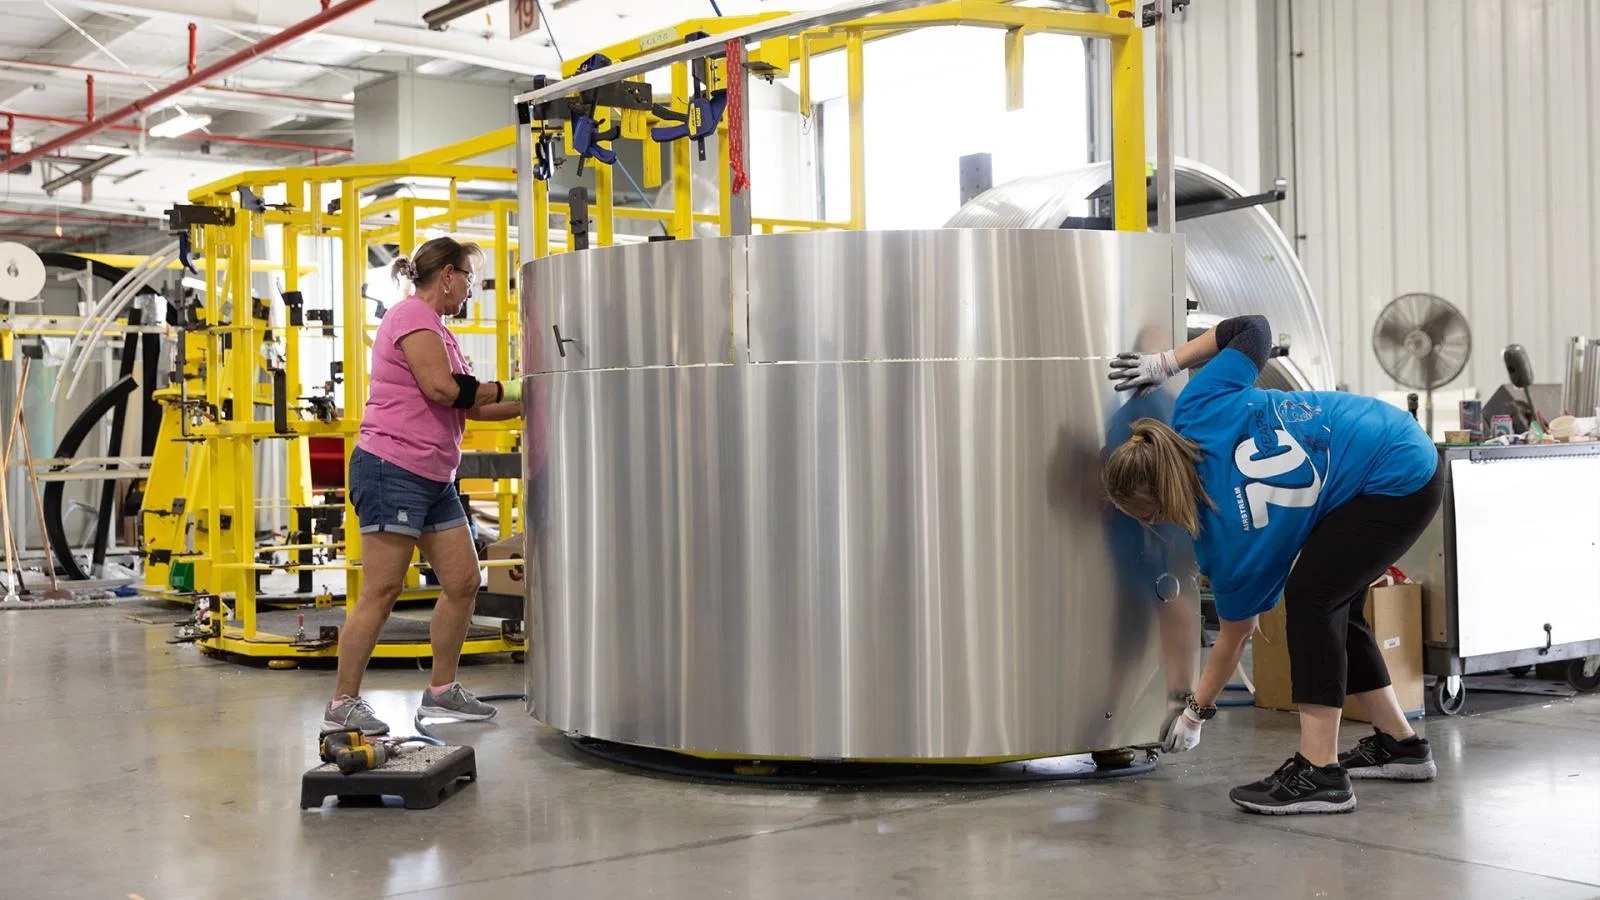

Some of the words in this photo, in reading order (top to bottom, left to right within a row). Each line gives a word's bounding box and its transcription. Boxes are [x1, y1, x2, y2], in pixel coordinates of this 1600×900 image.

[515, 0, 534, 32] 19
[1254, 410, 1275, 455] YEARS
[1234, 486, 1249, 532] AIRSTREAM
